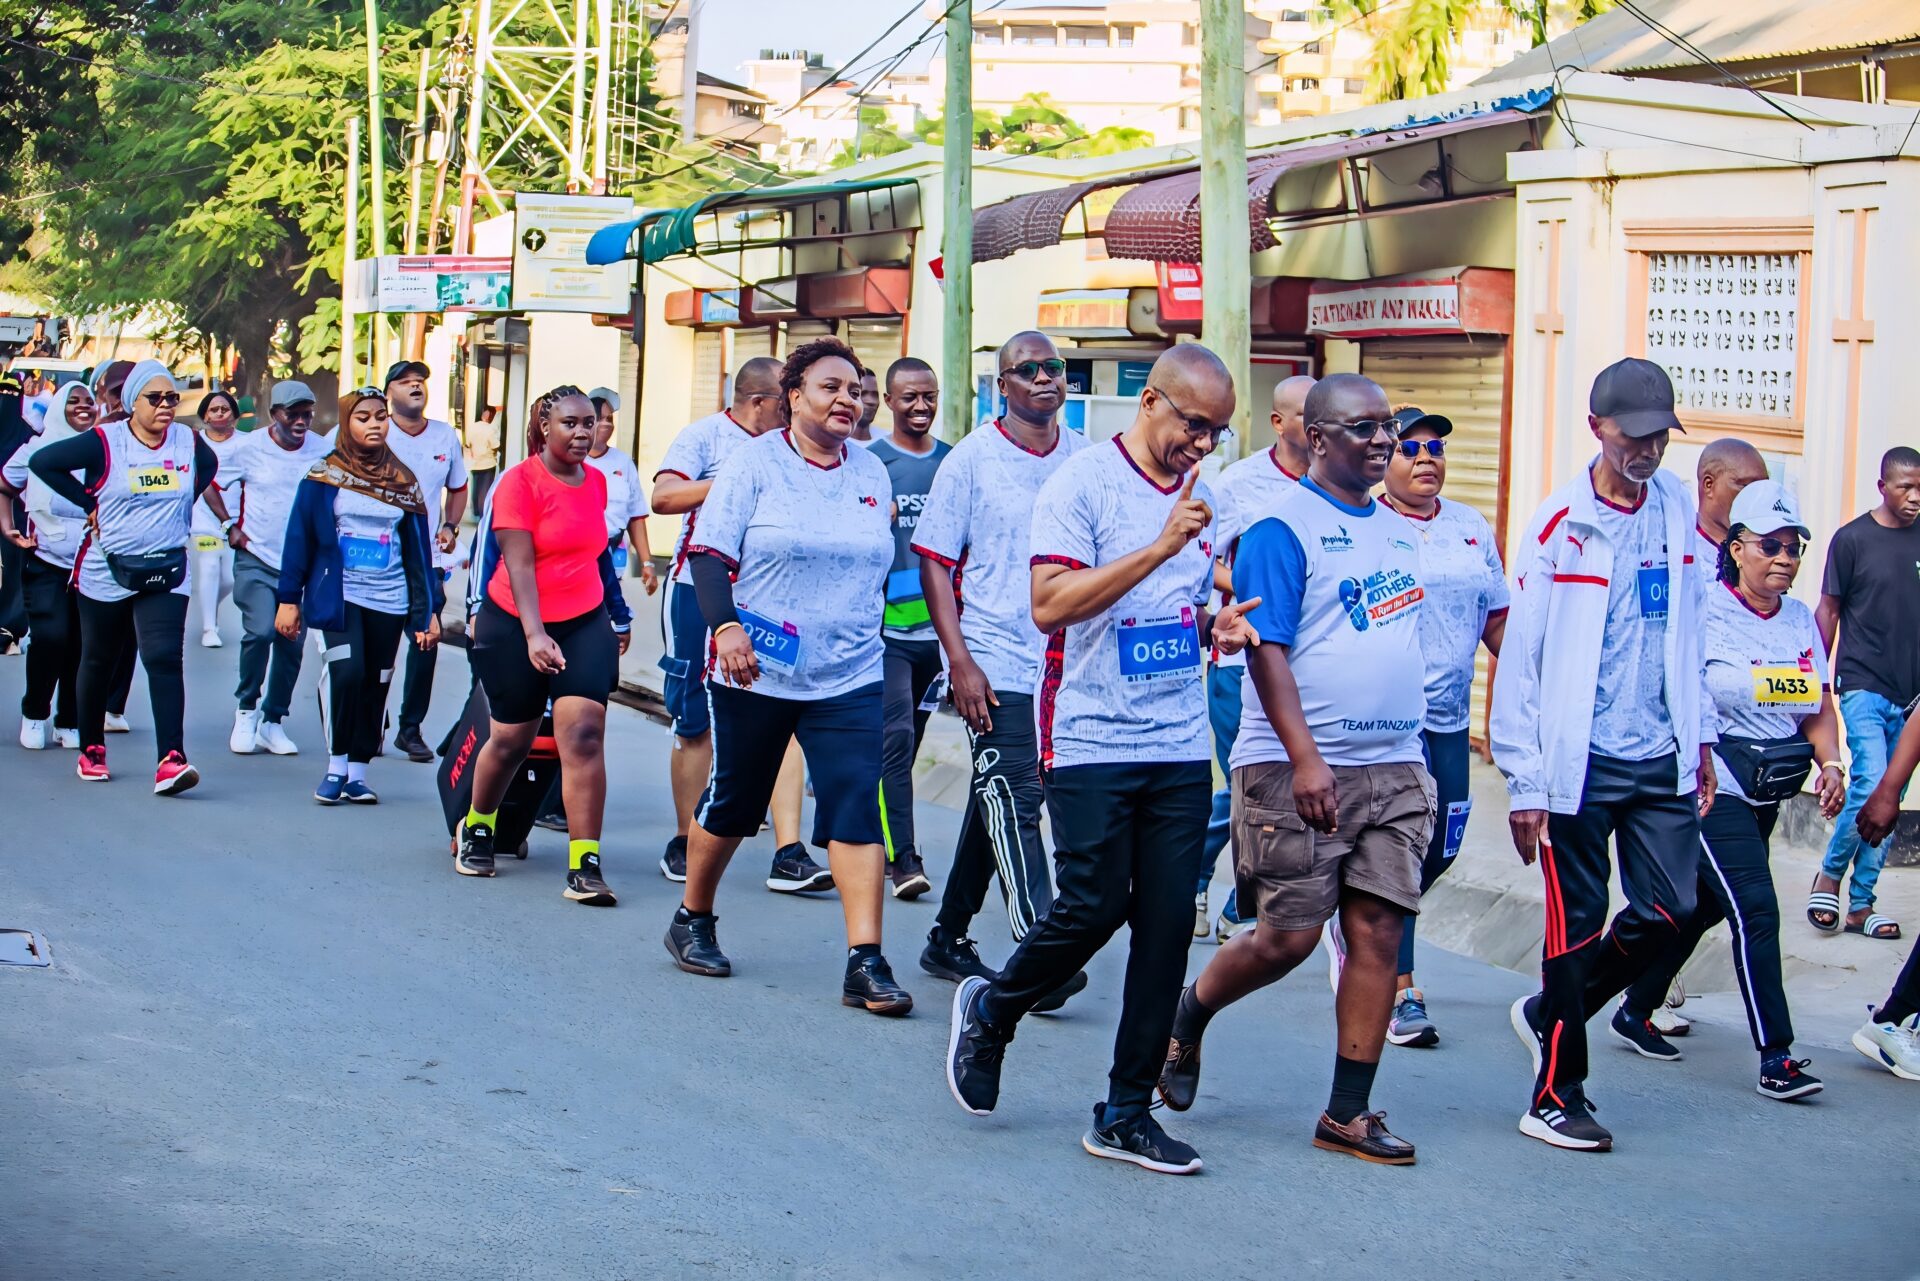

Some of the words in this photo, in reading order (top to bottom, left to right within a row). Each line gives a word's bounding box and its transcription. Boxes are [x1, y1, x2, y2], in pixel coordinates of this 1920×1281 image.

[1312, 299, 1376, 326] STATIONARY
[1381, 299, 1403, 320] AND
[1406, 299, 1458, 320] WAKALA
[1366, 573, 1416, 605] MOTHERS
[1133, 637, 1192, 663] 0634
[1765, 677, 1809, 695] 1433
[1342, 719, 1375, 732] TEAM
